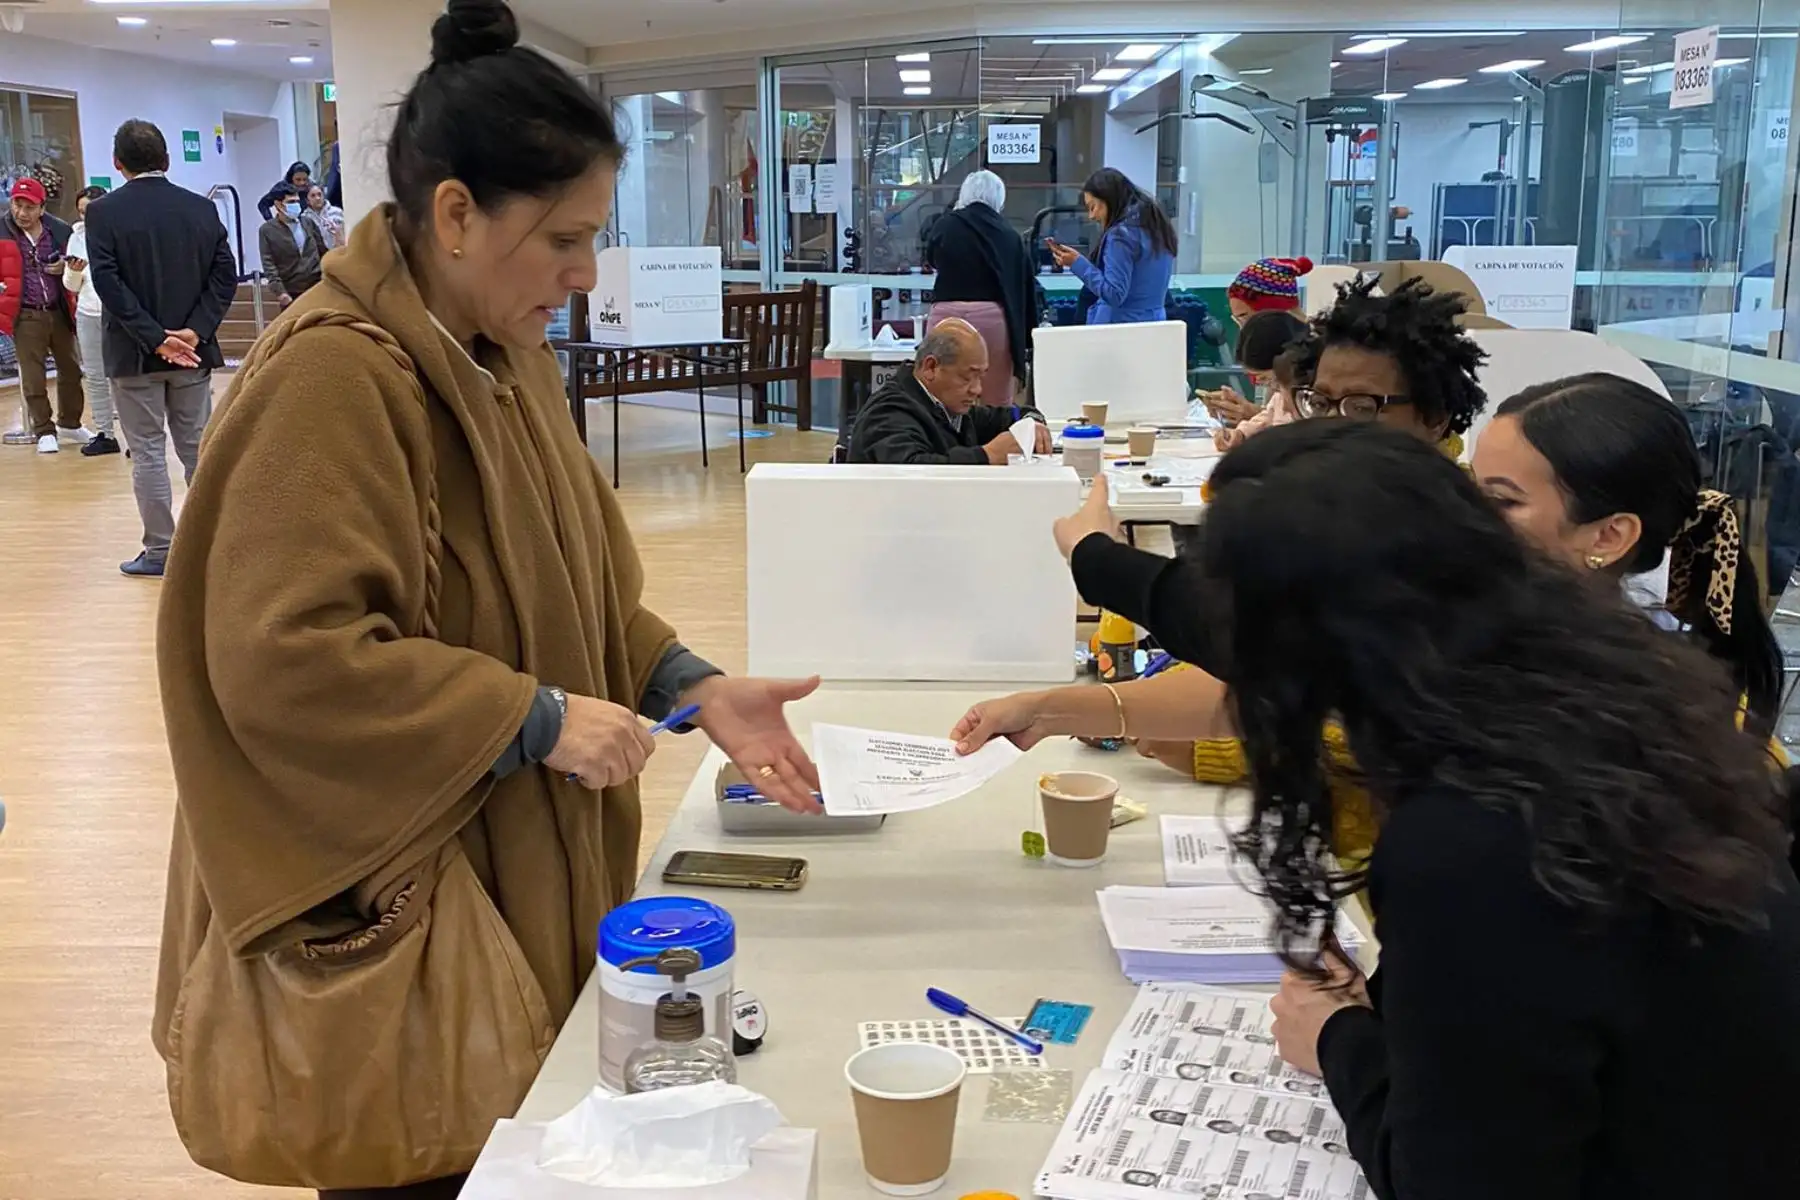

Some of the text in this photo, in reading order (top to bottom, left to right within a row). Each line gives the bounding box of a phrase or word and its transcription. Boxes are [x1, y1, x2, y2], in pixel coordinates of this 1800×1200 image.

[1680, 46, 1700, 62] MESA
[996, 132, 1020, 140] MESA
[992, 143, 1035, 154] 083364
[640, 261, 713, 271] CABINA DE VOTACIÓN
[1475, 261, 1565, 270] CABINA DE VOTACIÓN
[600, 312, 622, 324] ONPE
